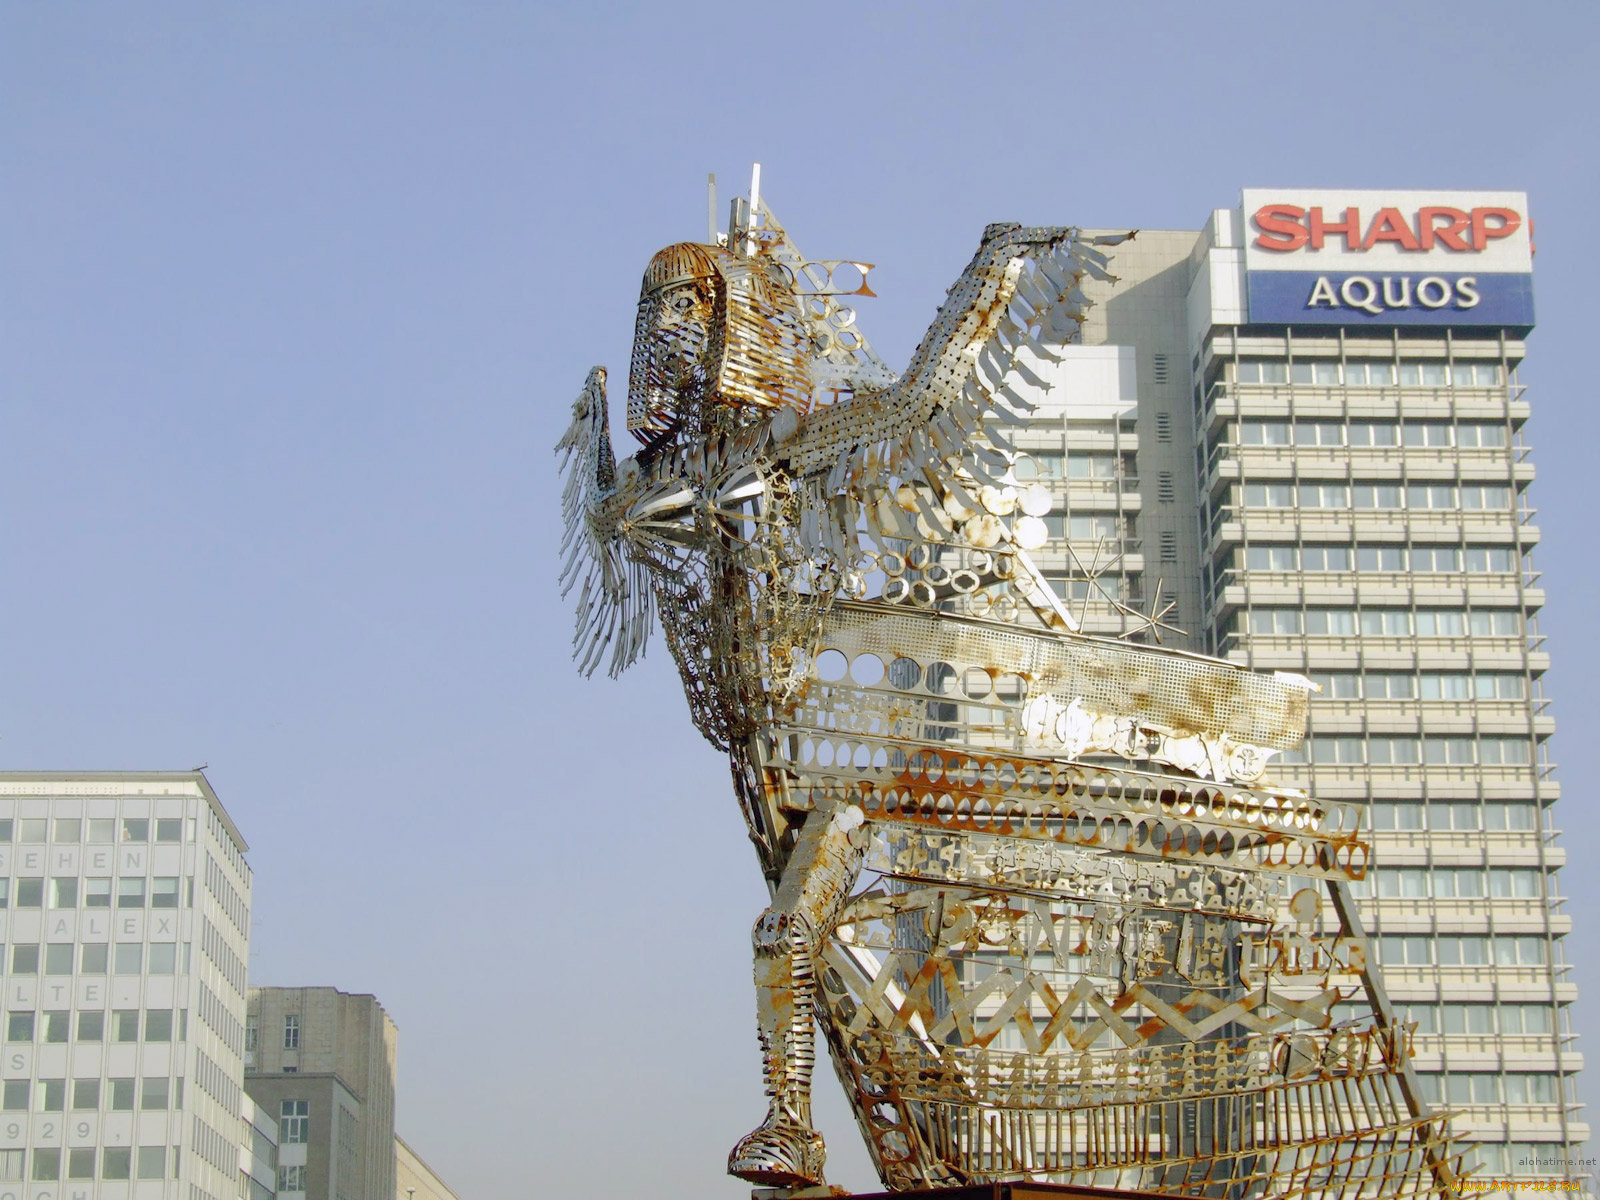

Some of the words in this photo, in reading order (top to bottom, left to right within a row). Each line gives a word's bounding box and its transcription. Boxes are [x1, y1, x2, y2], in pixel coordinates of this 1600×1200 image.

[1255, 204, 1521, 251] SHARP
[1308, 276, 1480, 314] AQUOS
[0, 853, 141, 869] EHEN
[54, 918, 170, 934] ALEX
